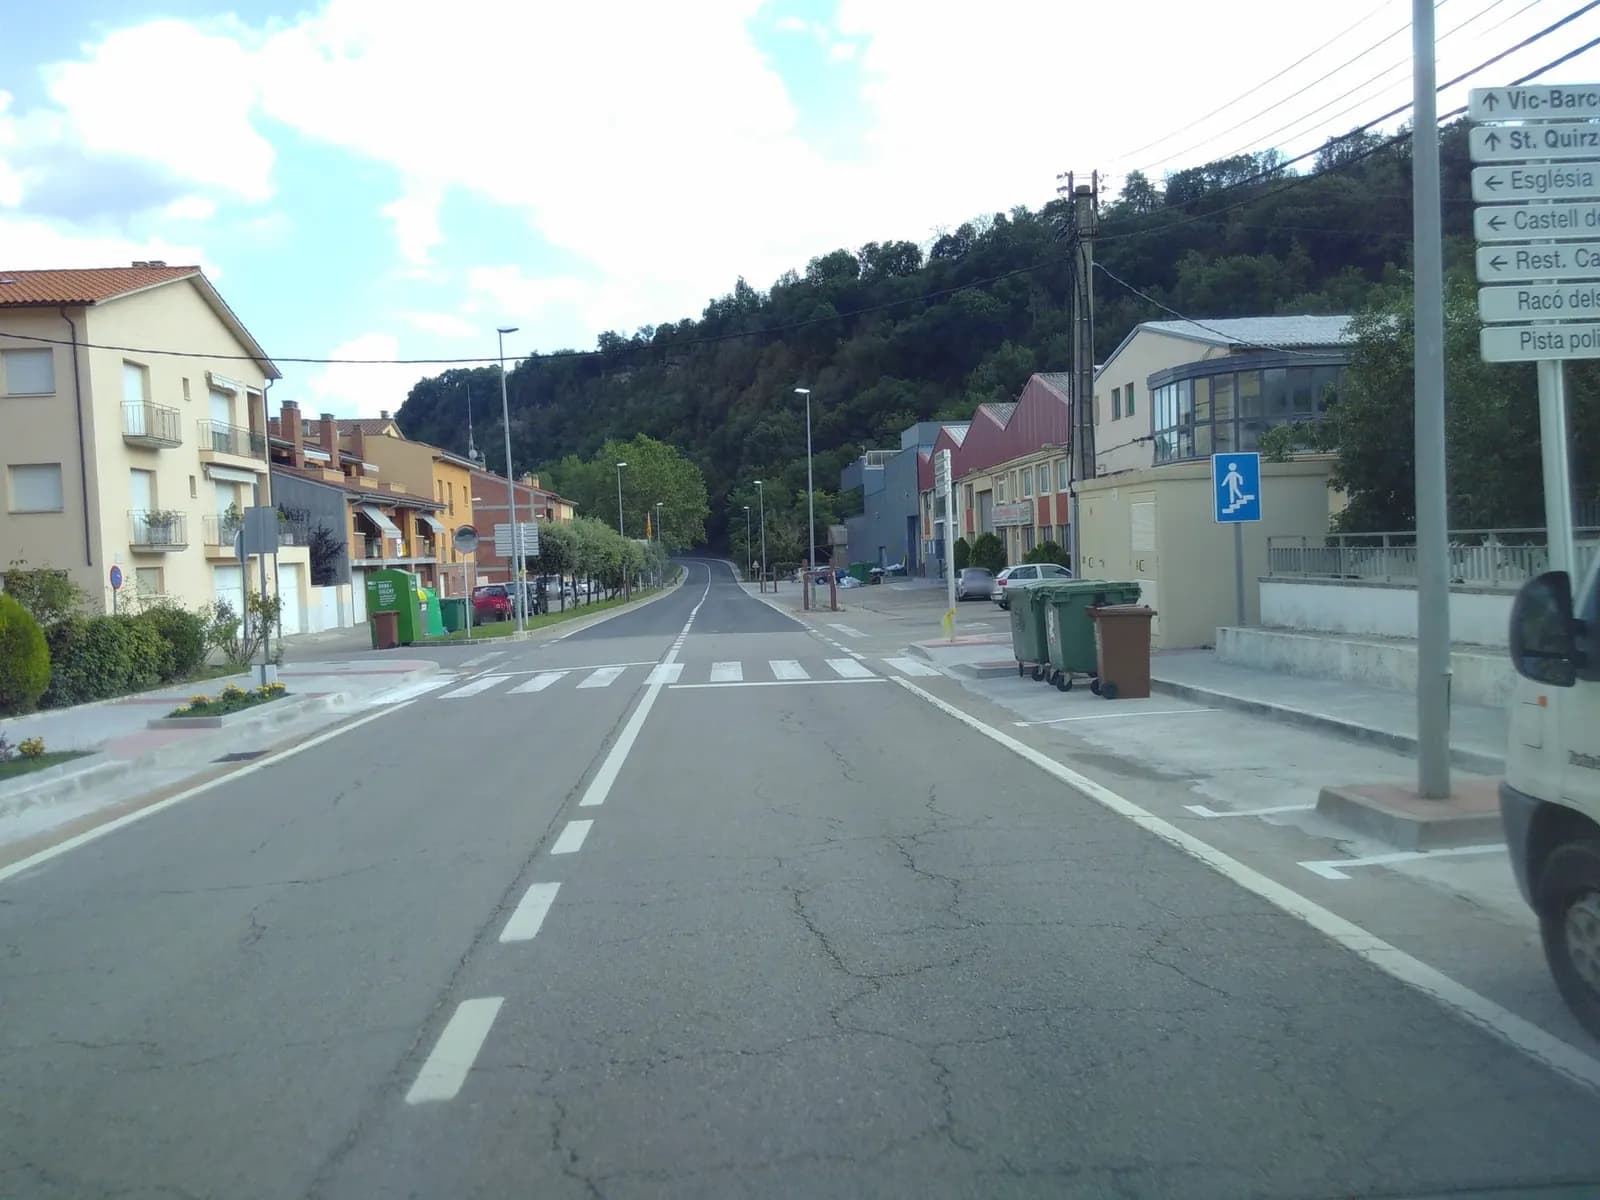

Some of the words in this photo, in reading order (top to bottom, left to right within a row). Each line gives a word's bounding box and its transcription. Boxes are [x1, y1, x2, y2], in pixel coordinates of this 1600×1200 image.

[1507, 89, 1600, 110] Vic-Barc
[1510, 131, 1537, 149] St.
[1545, 128, 1600, 150] Quirz
[1511, 168, 1593, 193] Església
[1514, 209, 1578, 230] Castell
[1516, 249, 1567, 270] Rest.
[1518, 289, 1563, 312] Racó
[1520, 330, 1564, 350] Pista
